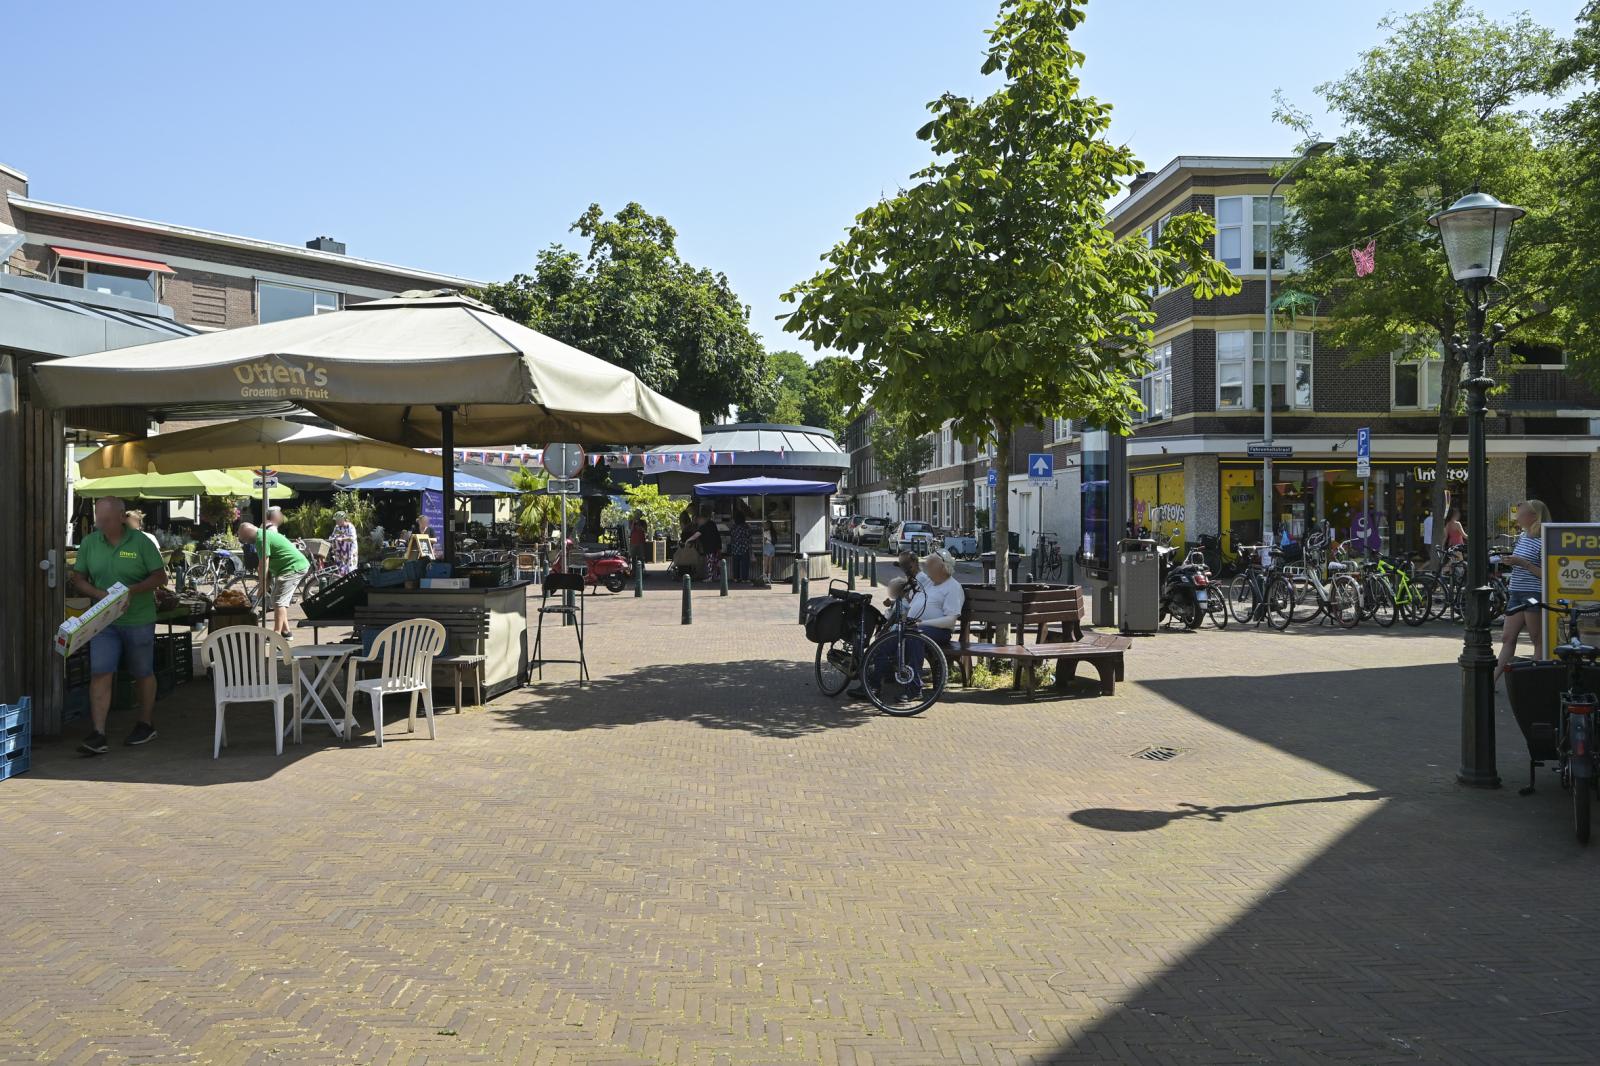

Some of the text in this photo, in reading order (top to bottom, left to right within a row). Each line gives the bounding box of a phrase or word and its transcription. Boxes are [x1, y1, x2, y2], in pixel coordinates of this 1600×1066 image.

[233, 362, 328, 386] Otten's
[241, 387, 329, 399] Groenten en fruit
[1417, 467, 1469, 481] Inttoy
[1561, 532, 1600, 549] Pra
[1561, 568, 1592, 580] 40%
